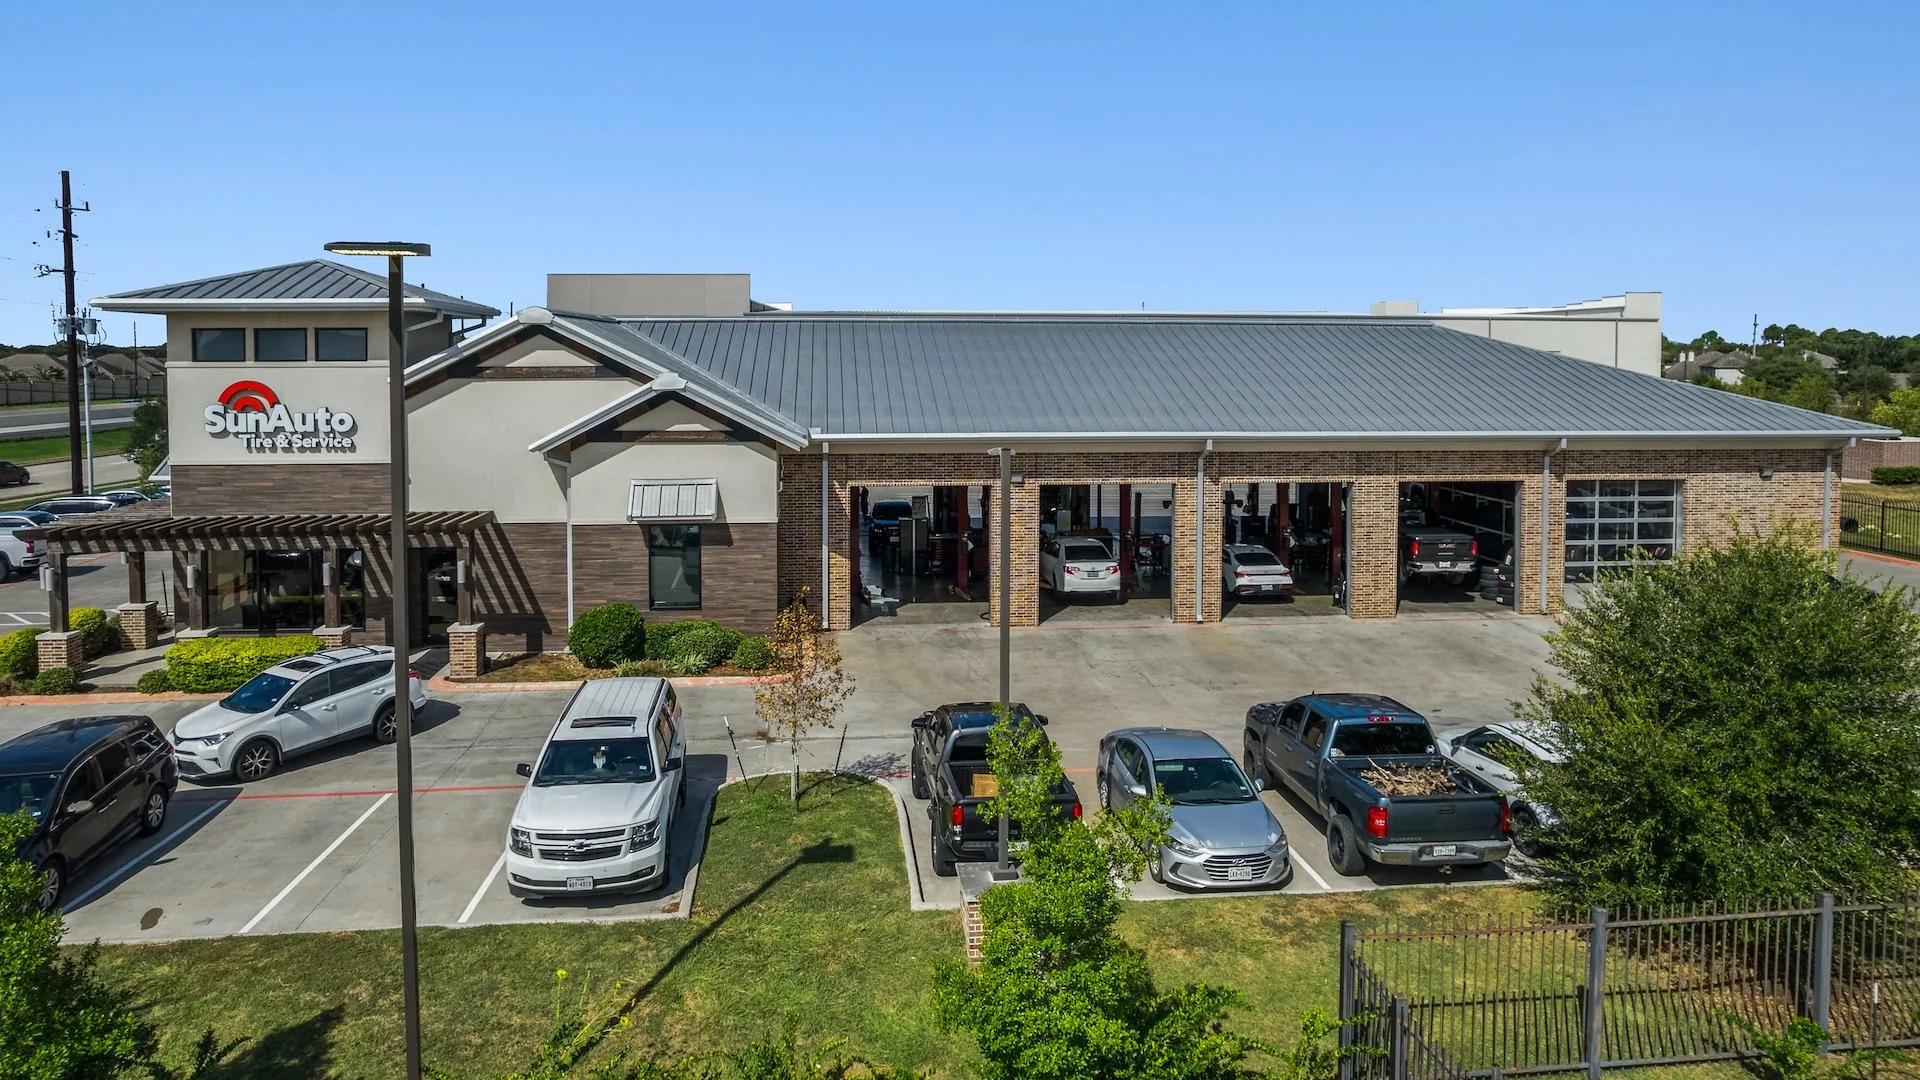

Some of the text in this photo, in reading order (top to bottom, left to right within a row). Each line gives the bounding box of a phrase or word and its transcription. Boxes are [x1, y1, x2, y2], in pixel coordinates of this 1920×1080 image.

[204, 404, 354, 433] SunAuto
[239, 434, 352, 448] Tire & Service
